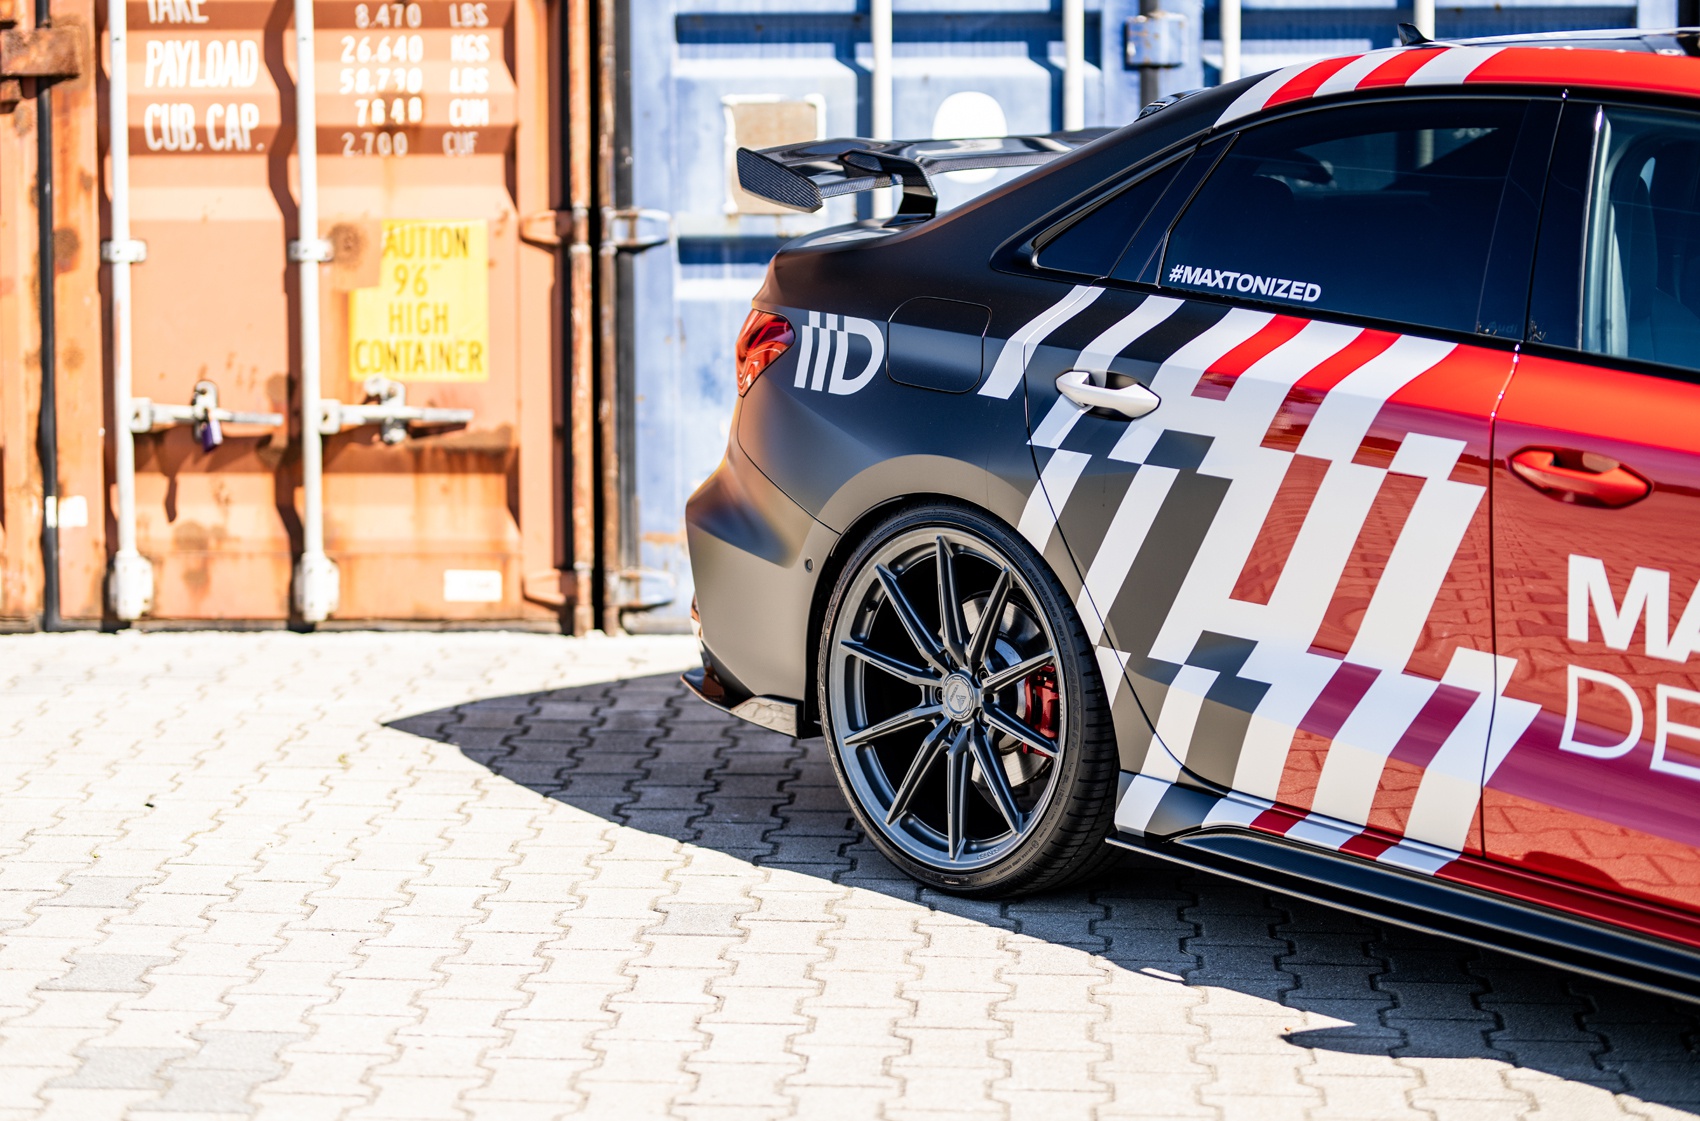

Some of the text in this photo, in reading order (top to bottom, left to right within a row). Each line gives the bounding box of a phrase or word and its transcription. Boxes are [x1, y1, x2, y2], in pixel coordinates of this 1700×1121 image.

[355, 3, 489, 29] 8.470 LBS
[145, 40, 259, 88] PAYLOAD
[340, 35, 490, 63] 26.640 KGS
[449, 67, 489, 93] LBS
[449, 98, 489, 127] CUM
[341, 131, 479, 157] 2.700 CUF
[1169, 264, 1322, 302] #MAXTONIZED
[388, 302, 449, 335] HIGH
[354, 339, 483, 374] CONTAINER
[1558, 664, 1700, 782] DE
